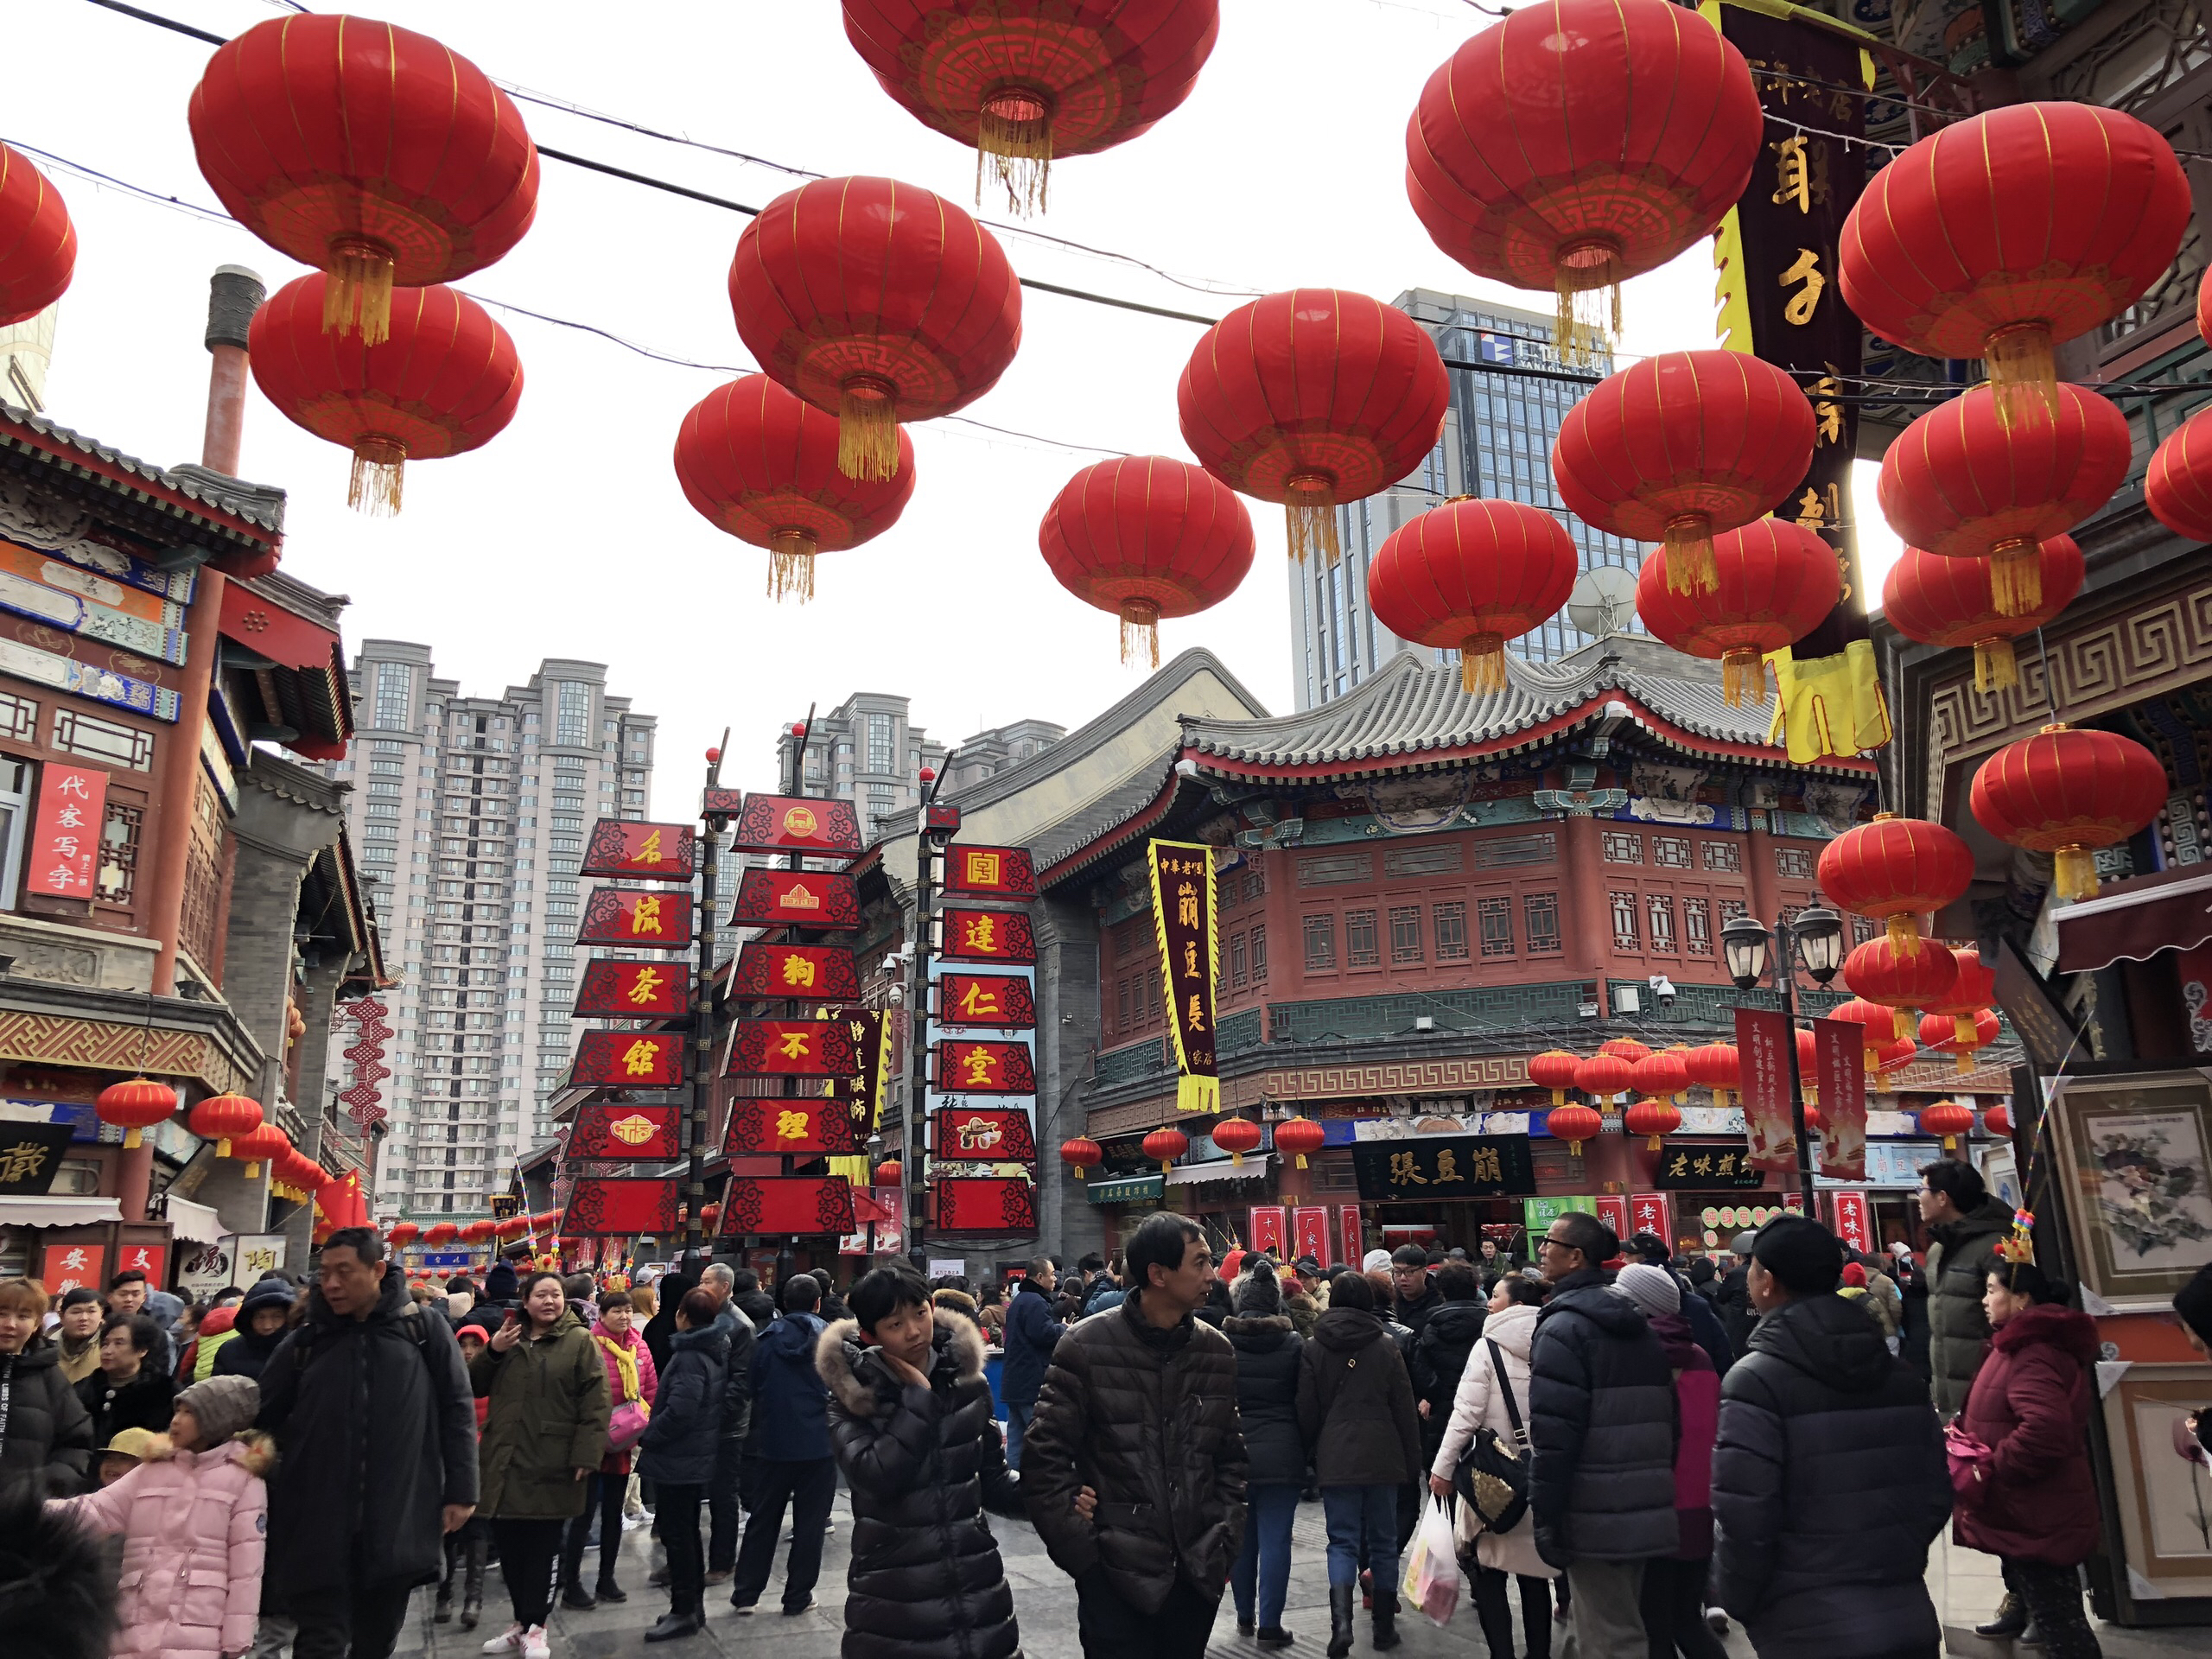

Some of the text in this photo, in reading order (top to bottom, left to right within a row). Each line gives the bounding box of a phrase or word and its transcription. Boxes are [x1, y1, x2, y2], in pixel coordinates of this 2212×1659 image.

[48, 775, 89, 889] 代客写字
[1187, 1049, 1212, 1065] 家店
[1262, 1217, 1275, 1249] 十八
[131, 1248, 151, 1270] 文
[245, 1247, 276, 1272] 陶
[1, 1402, 9, 1412] OF
